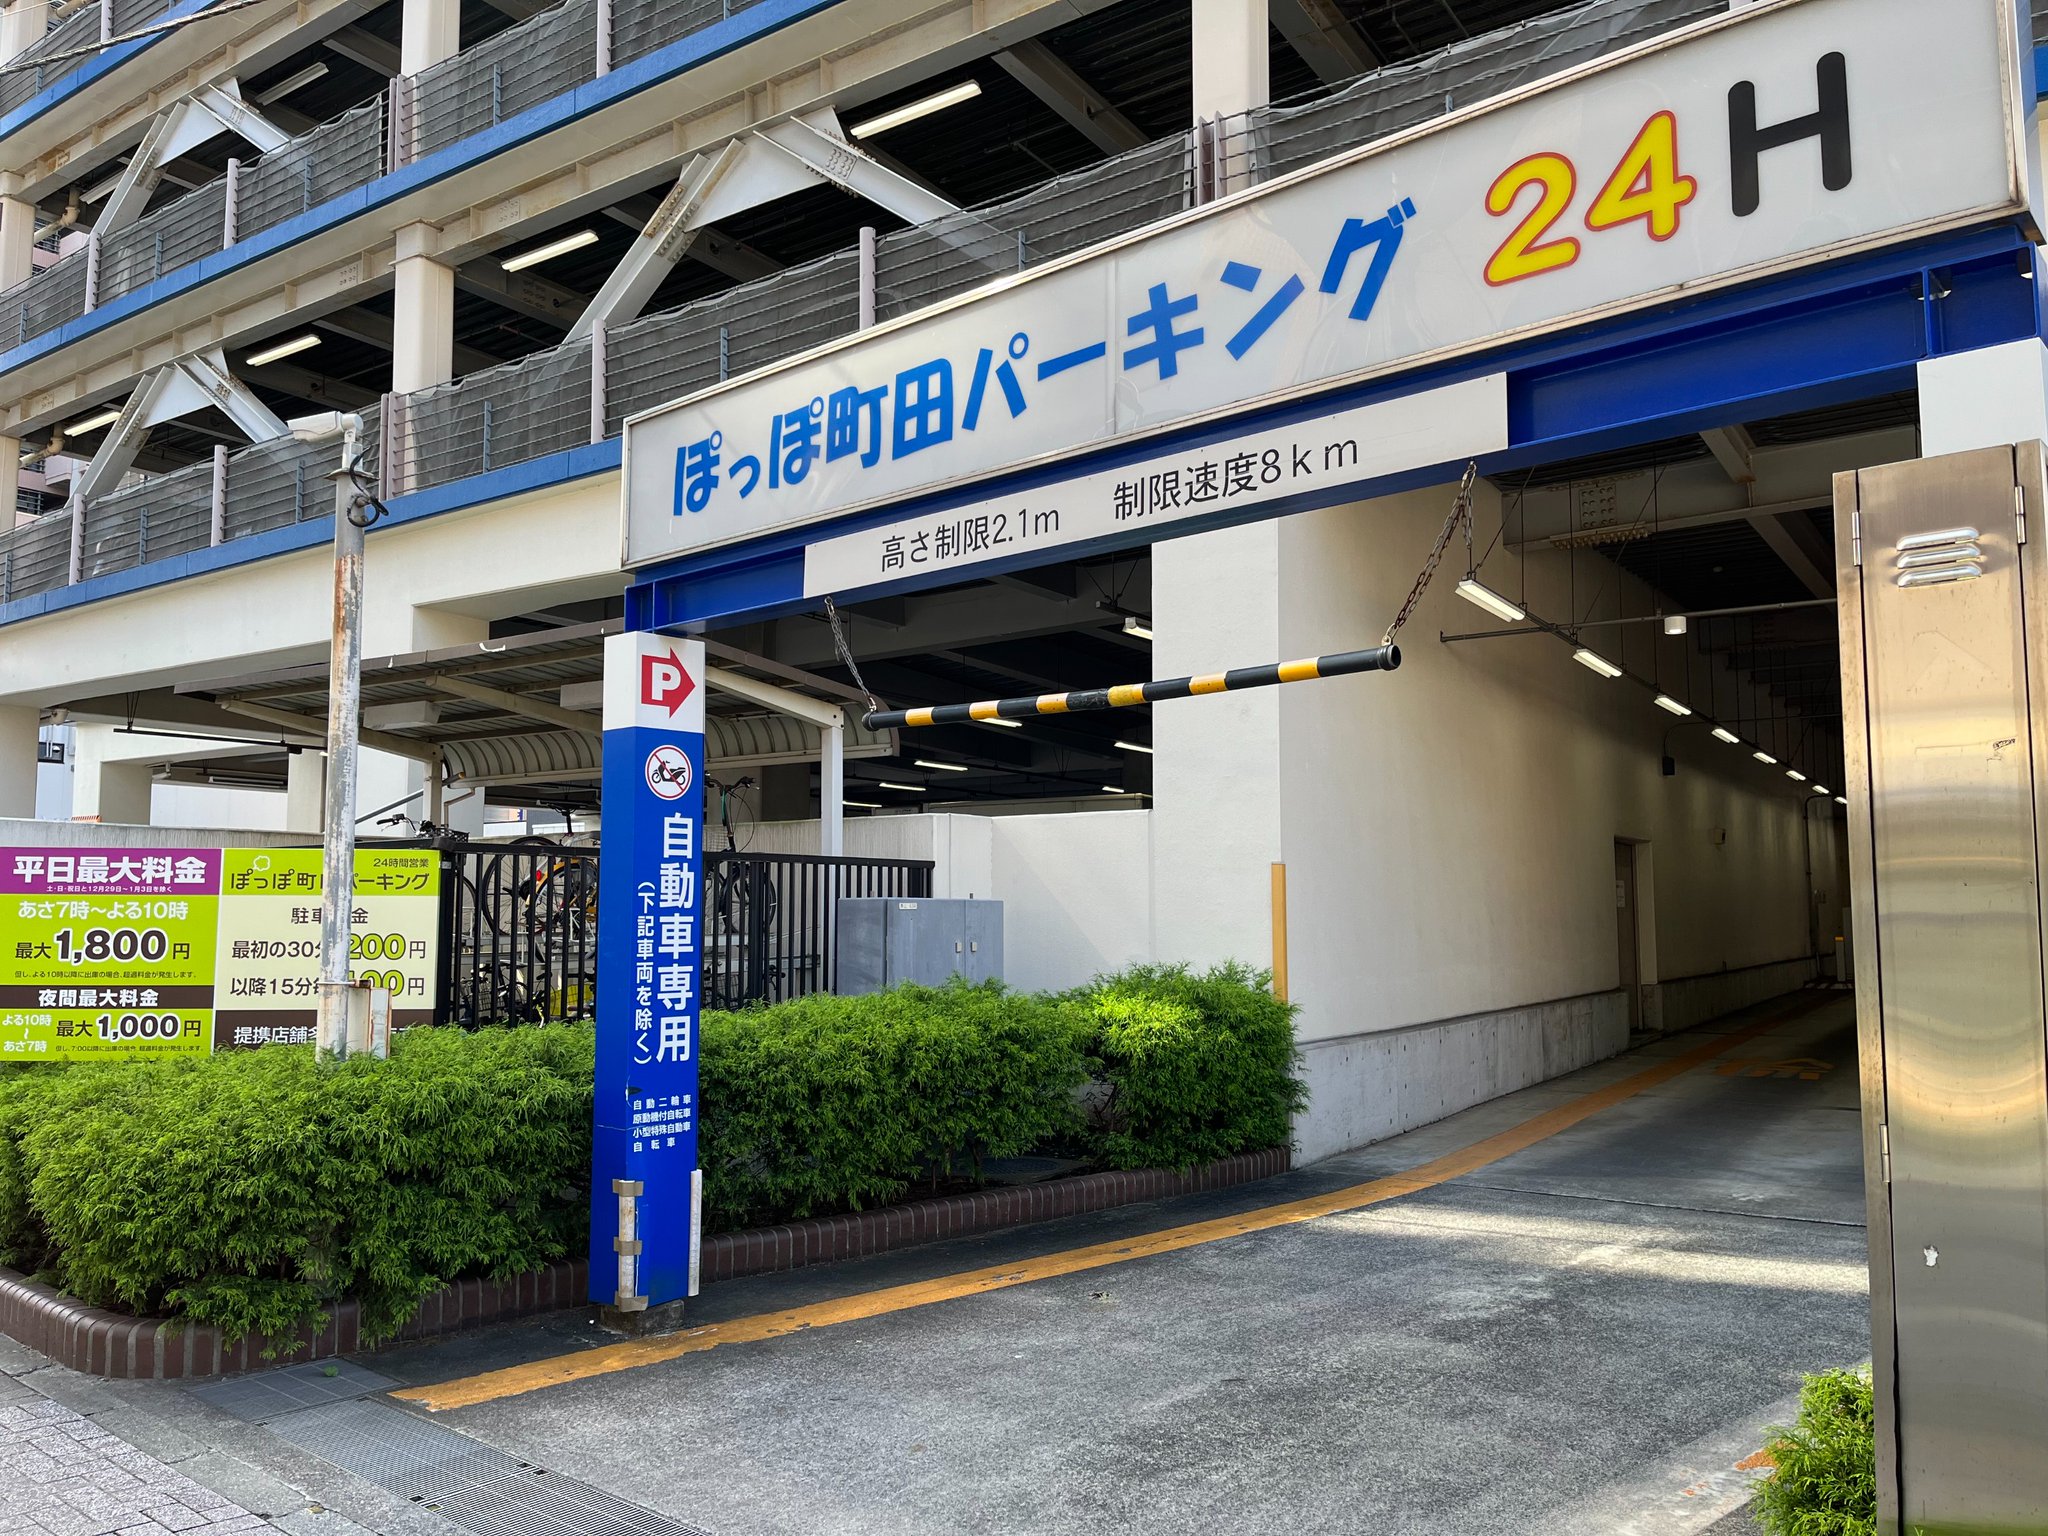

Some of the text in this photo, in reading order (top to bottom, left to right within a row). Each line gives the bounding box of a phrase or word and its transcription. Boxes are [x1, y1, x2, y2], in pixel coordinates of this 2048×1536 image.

[674, 197, 1417, 518] ぽっぽ町田パーキング
[881, 504, 1060, 572] 高さ制限2.1m
[651, 665, 681, 700] P
[13, 856, 207, 884] 平日最大料金
[373, 858, 429, 868] 24時間営業
[18, 900, 189, 920] あさ7時～よる10時
[291, 907, 368, 924] 駐車金
[656, 812, 695, 1063] 自動車専用
[634, 881, 656, 1065] （下記車両を除く）
[38, 989, 159, 1007] 夜間最大料金
[2, 1014, 51, 1026] よる10時
[3, 1040, 47, 1053] あさ7時
[633, 1108, 691, 1124] 原動機付自転車
[633, 1121, 691, 1138] 小型特殊自動車
